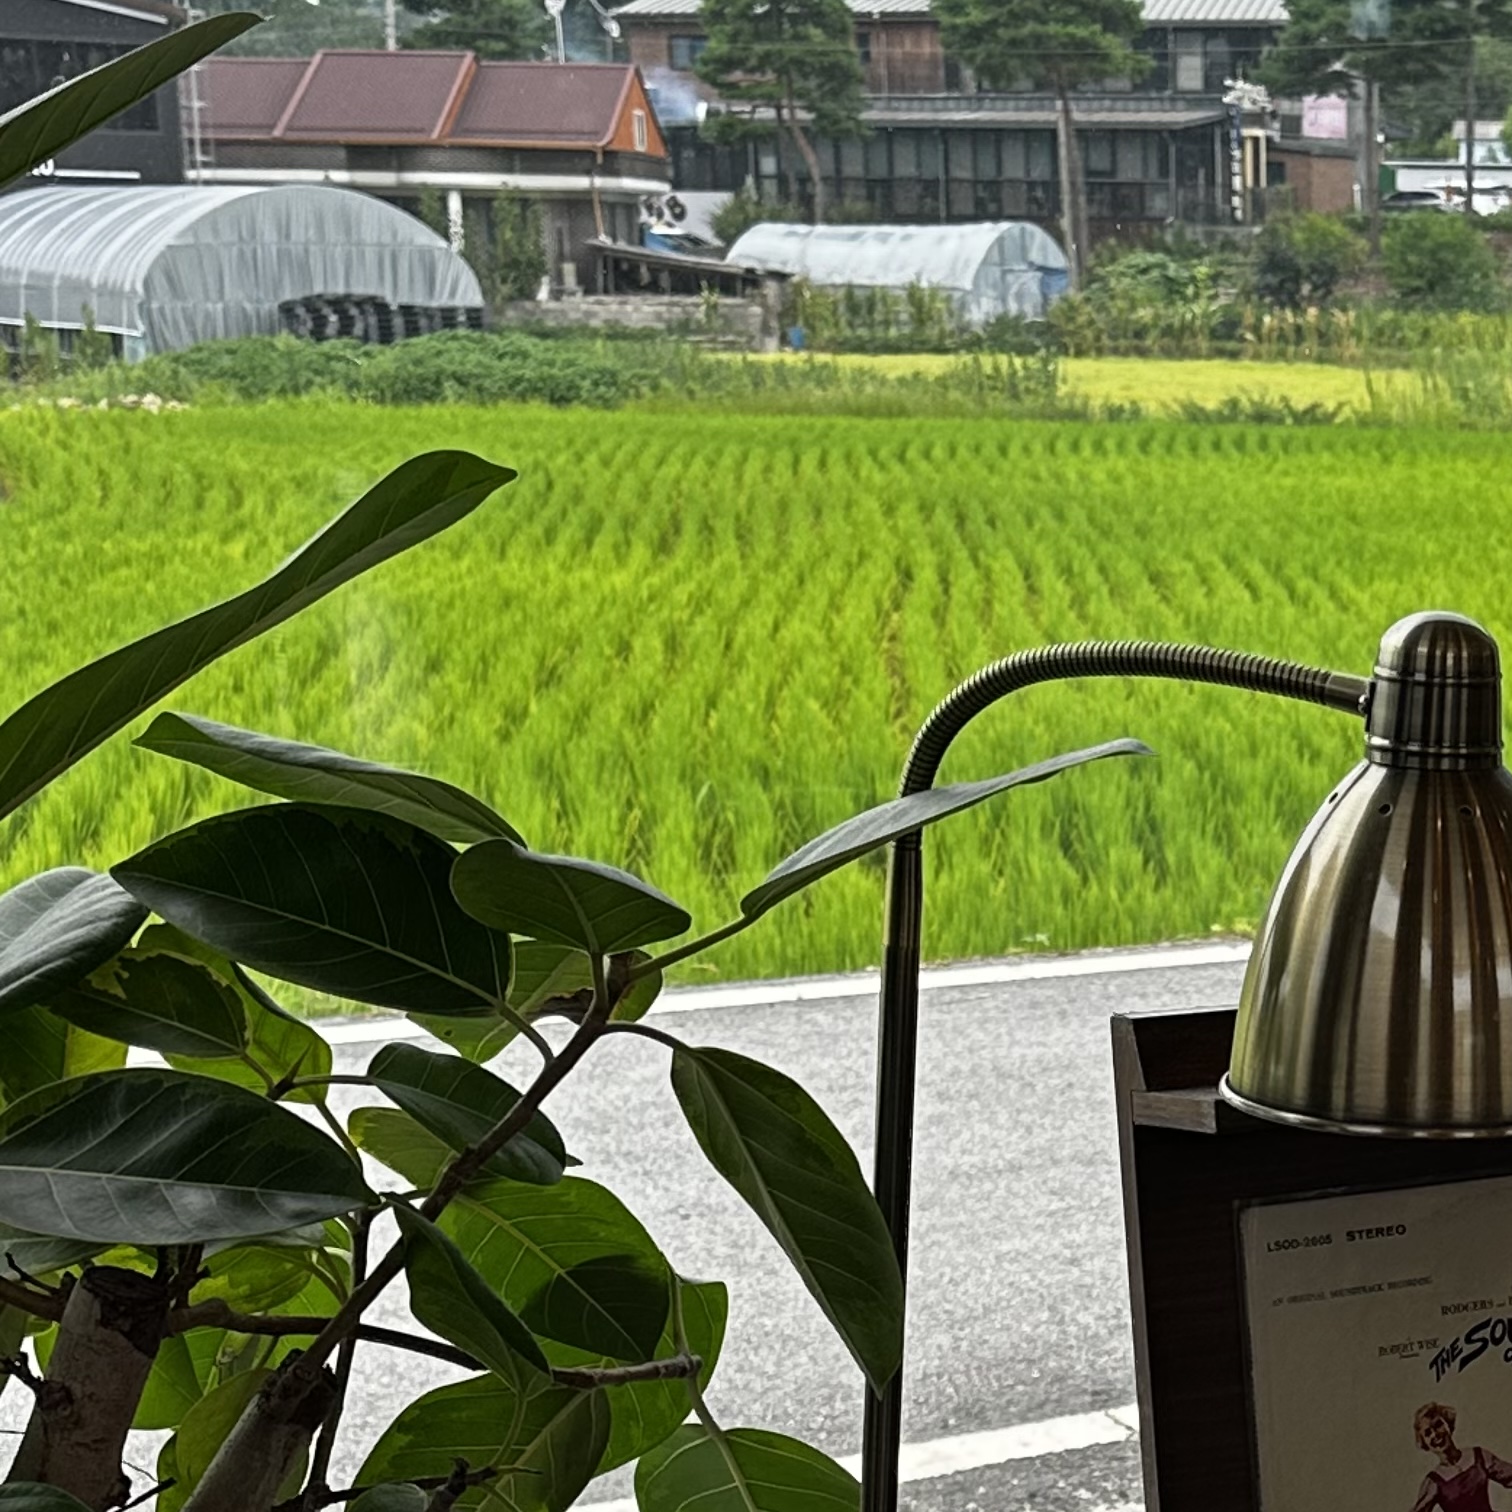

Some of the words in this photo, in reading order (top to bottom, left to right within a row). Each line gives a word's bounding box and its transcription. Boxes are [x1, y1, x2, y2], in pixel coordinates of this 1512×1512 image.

[1345, 1223, 1407, 1243] STEREO
[1439, 1297, 1495, 1317] RODGERS
[1428, 1336, 1464, 1383] THE
